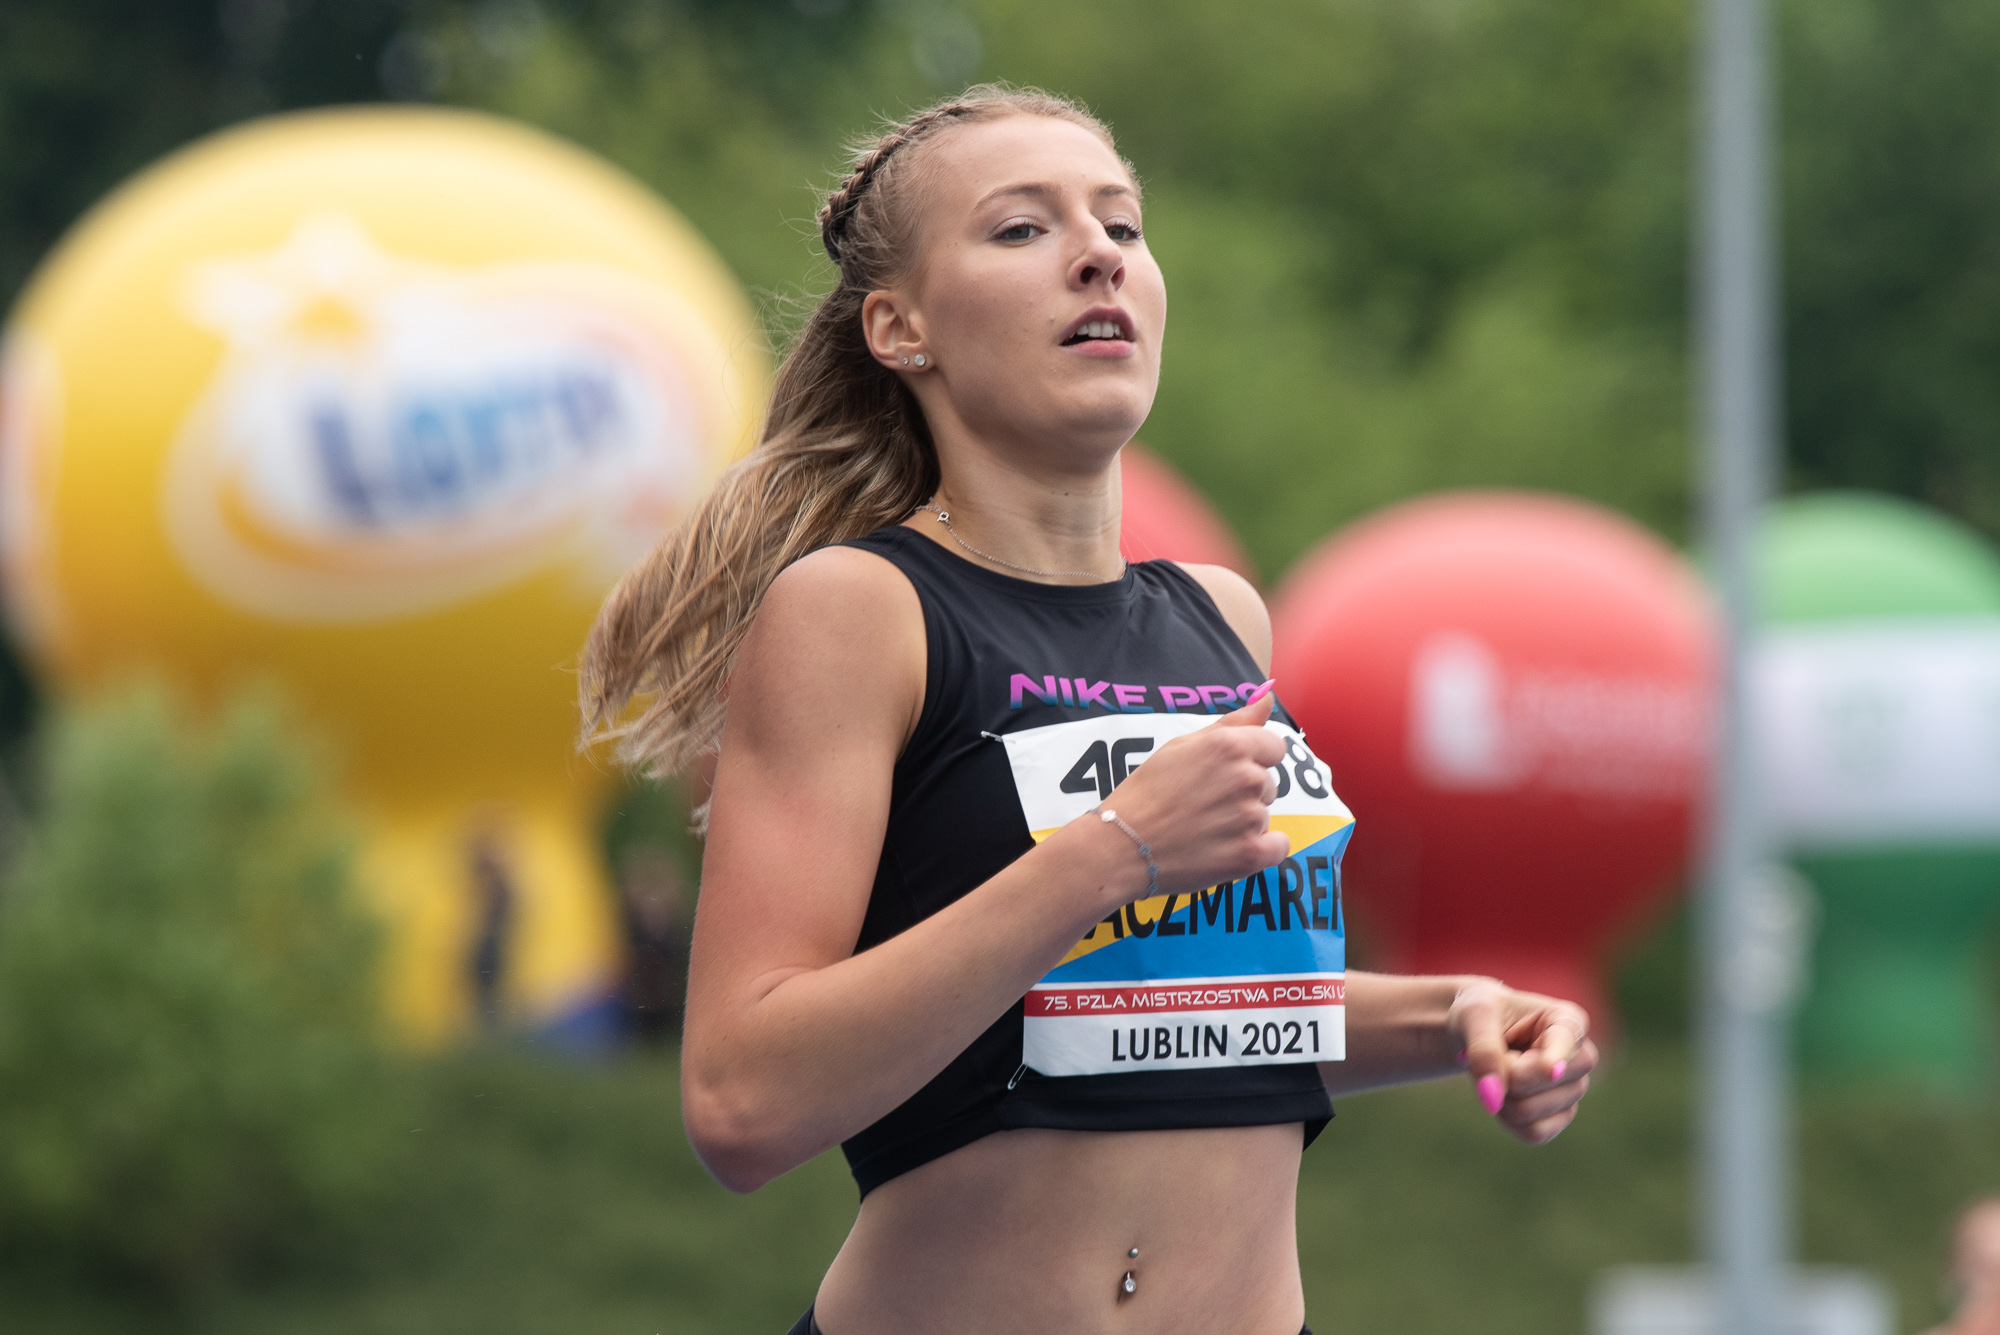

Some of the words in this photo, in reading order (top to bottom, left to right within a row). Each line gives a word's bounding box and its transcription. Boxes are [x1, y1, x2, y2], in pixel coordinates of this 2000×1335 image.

[1009, 673, 1154, 714] NIKE
[1043, 995, 1072, 1011] 75.
[1076, 994, 1127, 1010] PZLA
[1131, 987, 1270, 1009] MISTRZOSTWA
[1273, 985, 1335, 1001] POLSKI
[1112, 1023, 1229, 1062] LUBLIN
[1240, 1020, 1320, 1056] 2021
